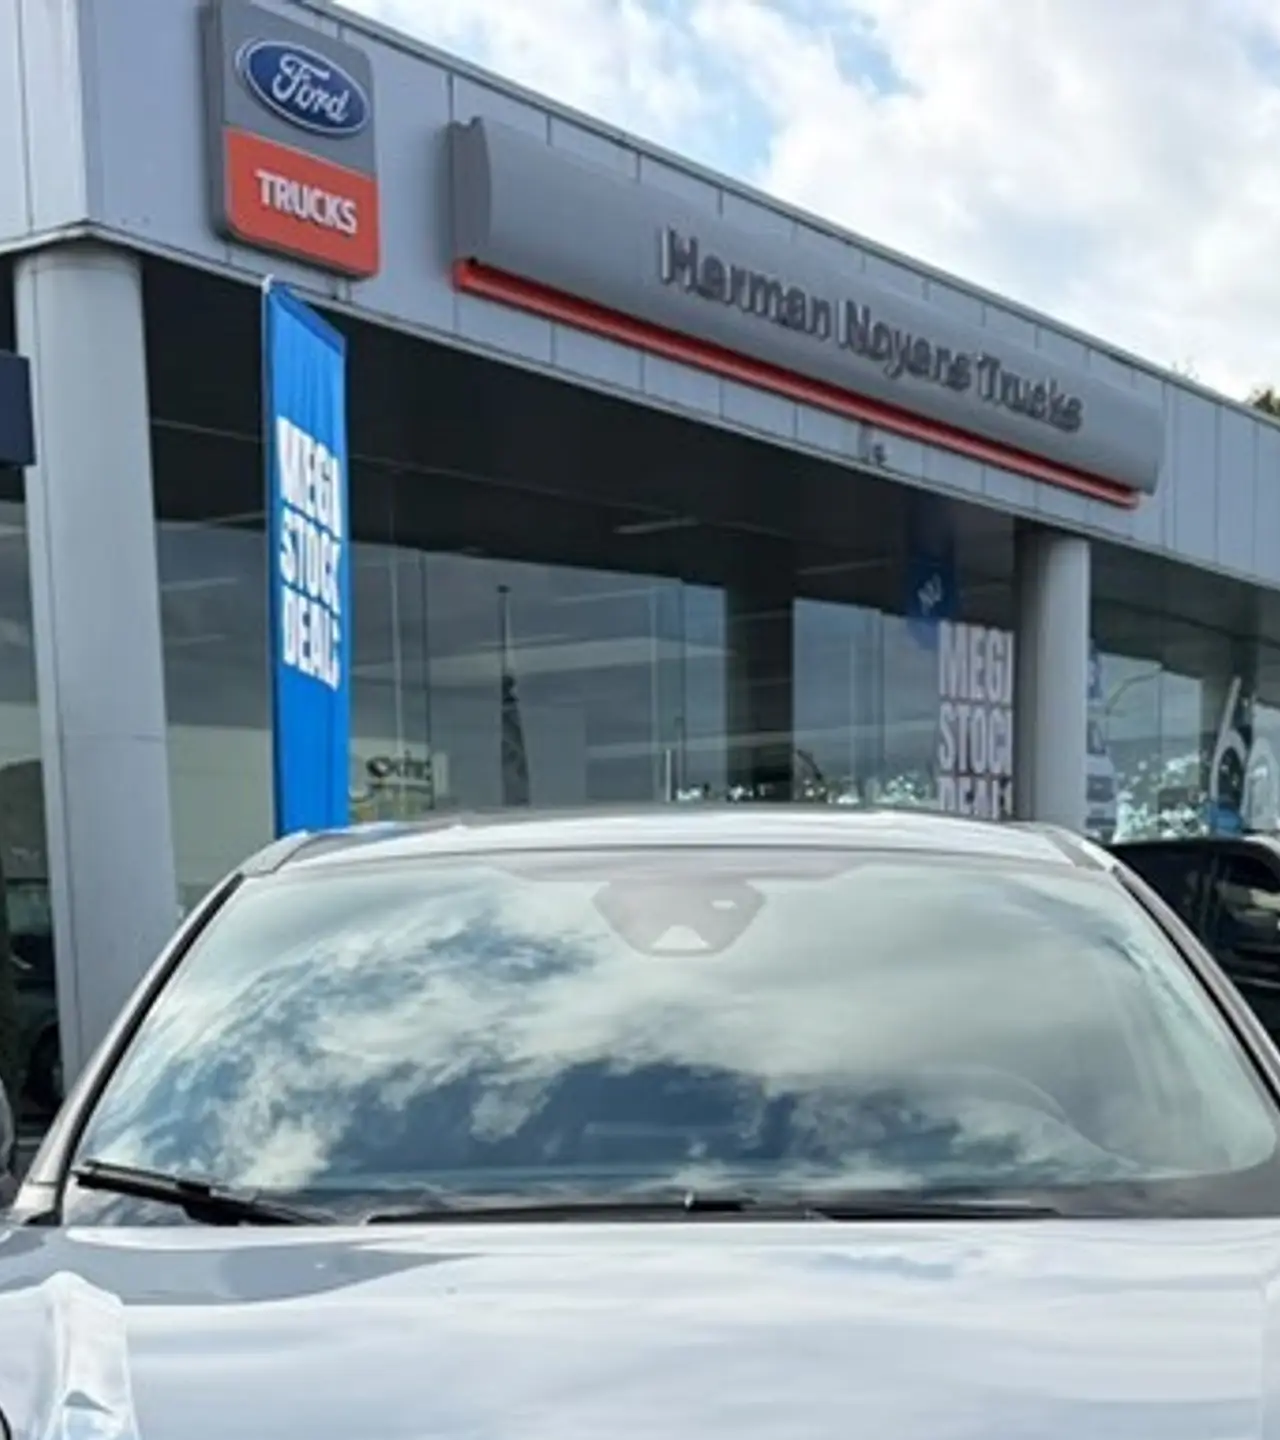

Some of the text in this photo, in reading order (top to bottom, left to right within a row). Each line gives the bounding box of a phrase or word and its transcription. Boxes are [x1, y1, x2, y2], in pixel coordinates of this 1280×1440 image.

[272, 52, 350, 124] Ford
[254, 168, 358, 236] TRUCKS
[659, 228, 831, 341] Herman
[975, 350, 1084, 434] Trucks
[276, 415, 342, 542] MEGA
[279, 508, 342, 618] STOCK
